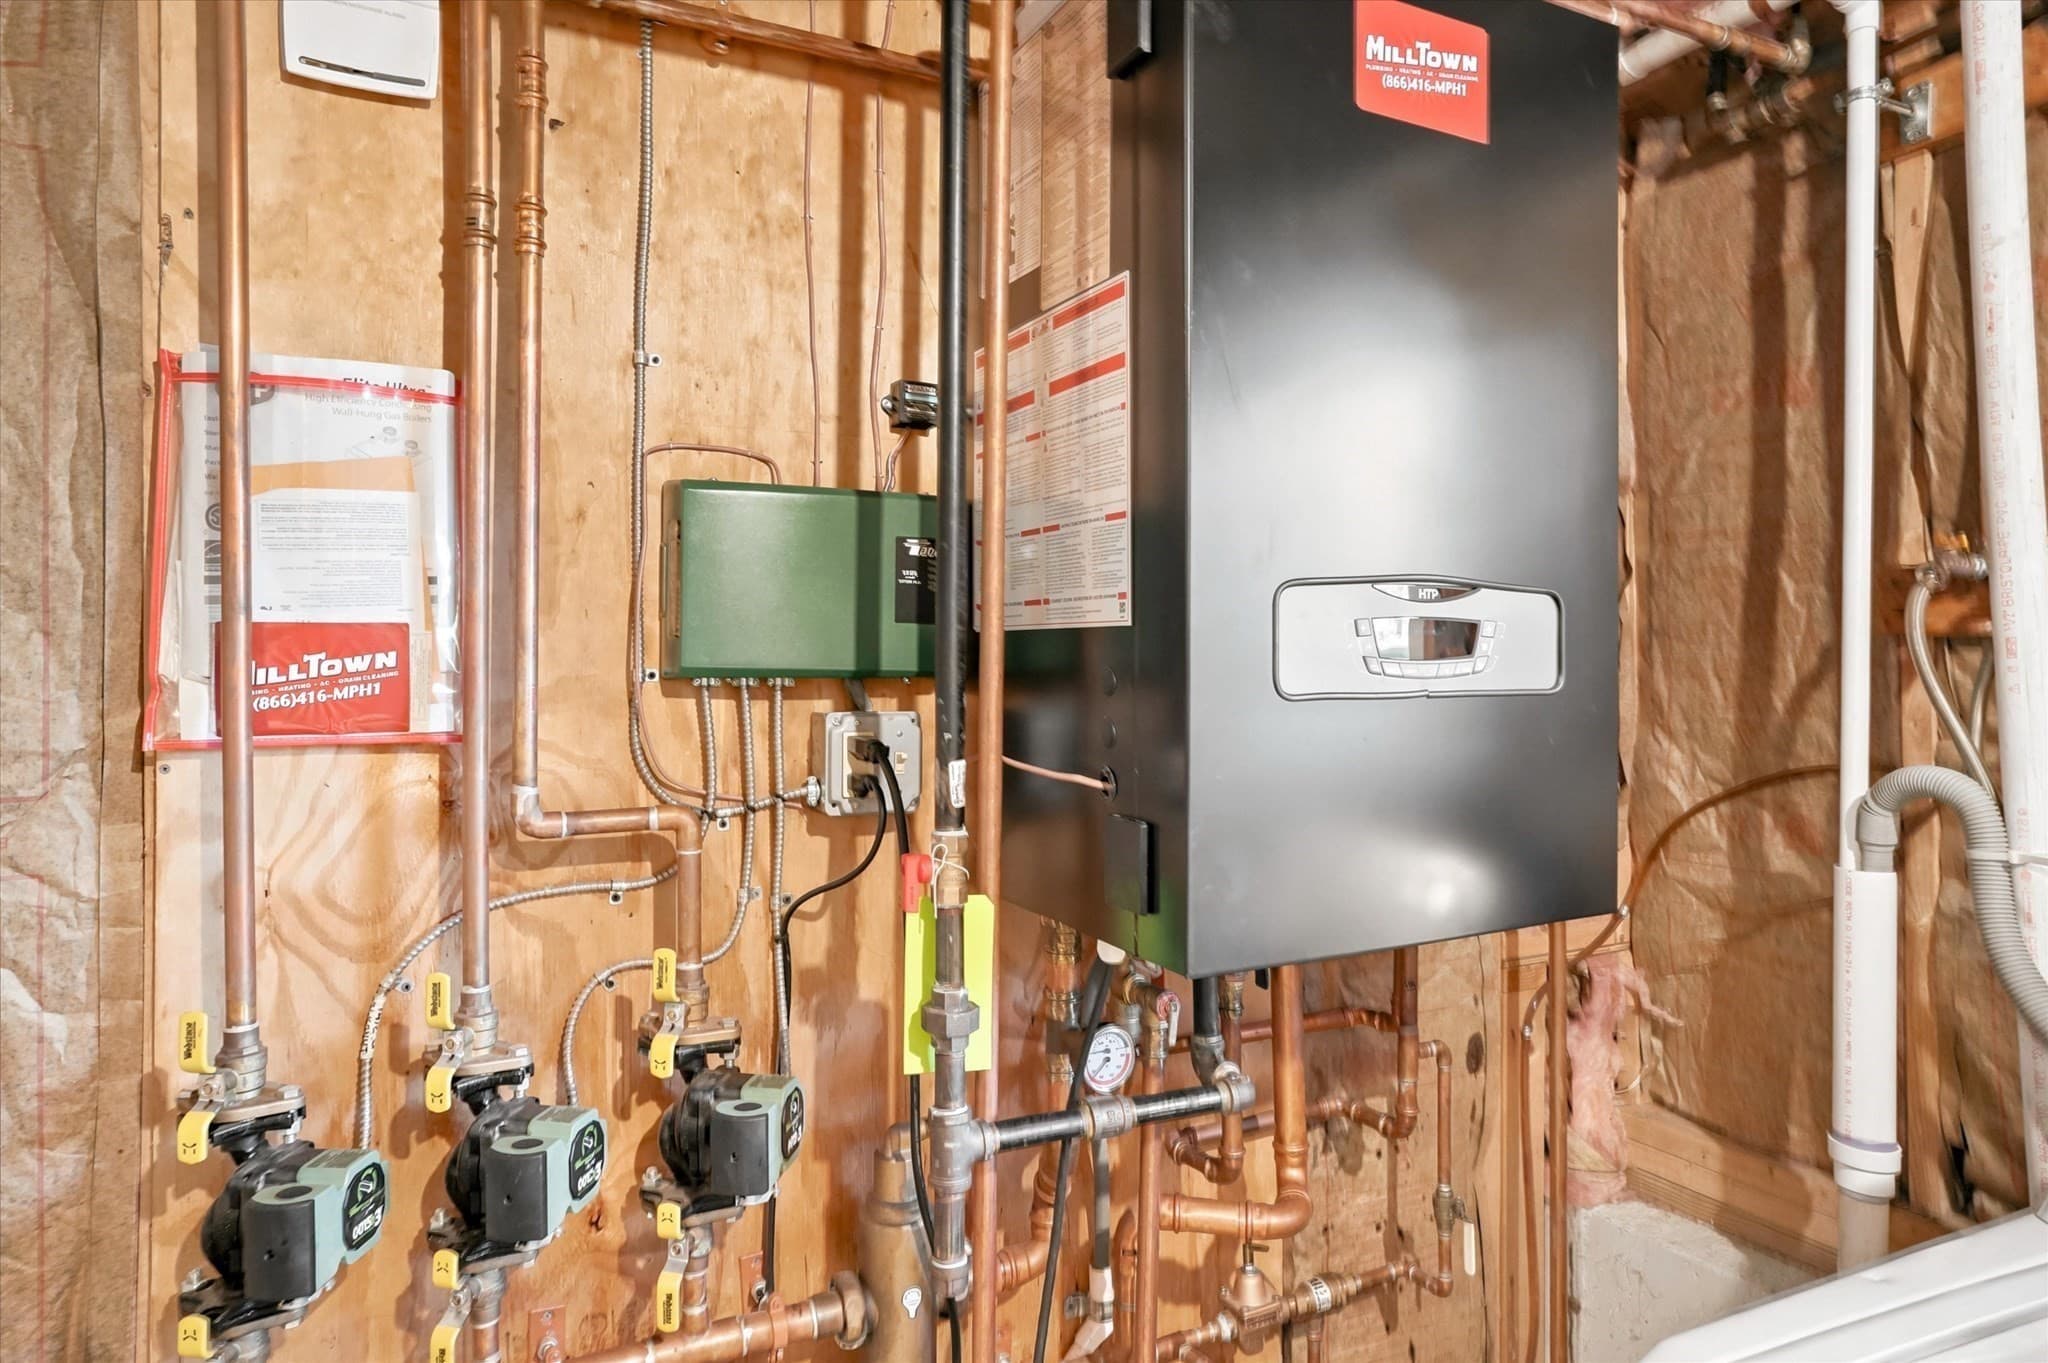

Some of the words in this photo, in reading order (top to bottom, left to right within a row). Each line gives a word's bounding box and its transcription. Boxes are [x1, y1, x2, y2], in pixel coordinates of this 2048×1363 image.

[1382, 73, 1466, 96] (866)416-MPH1
[1418, 589, 1439, 599] HTP
[251, 650, 397, 685] ILLTOWN
[278, 682, 311, 693] HEATING
[362, 670, 399, 681] CLEANING
[253, 682, 381, 712] (866)416-MPH1
